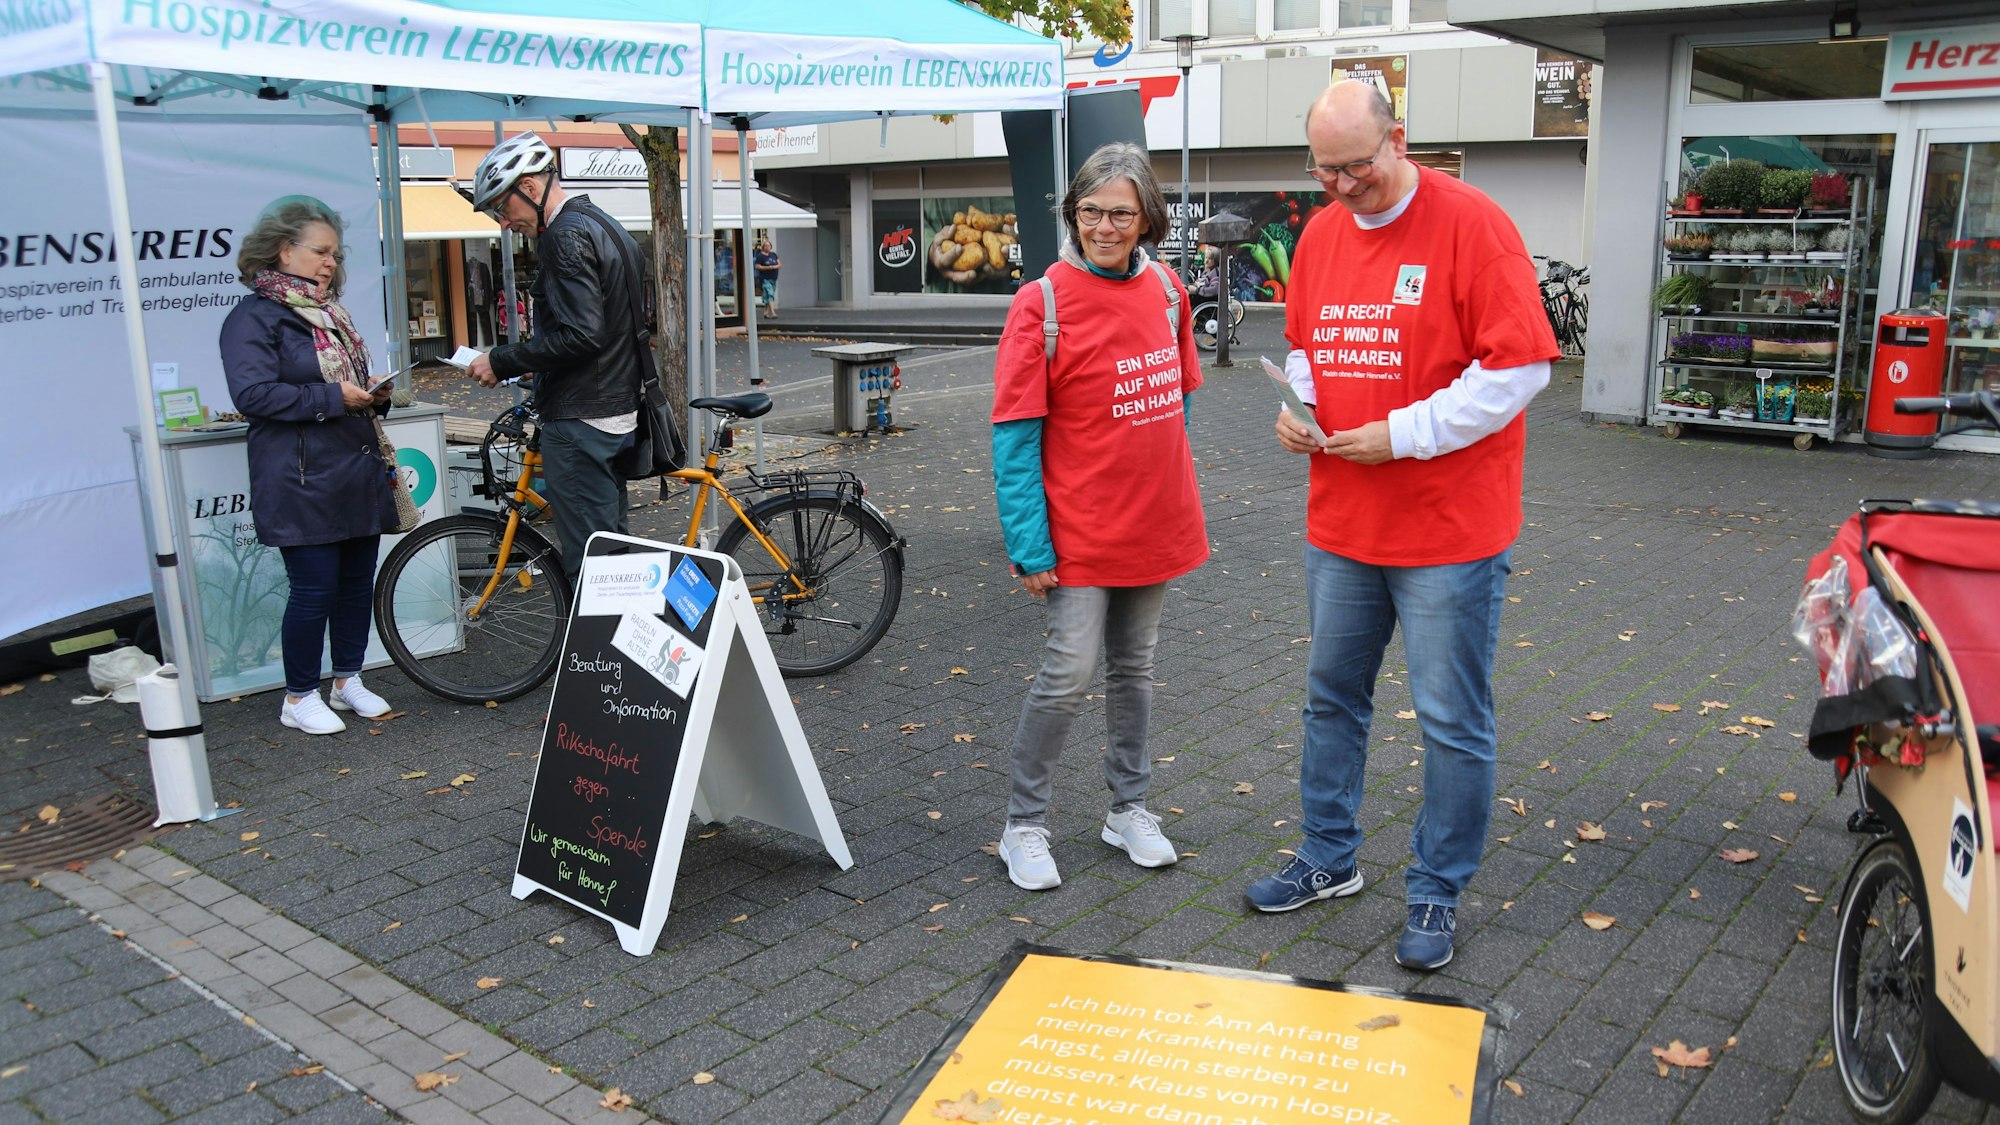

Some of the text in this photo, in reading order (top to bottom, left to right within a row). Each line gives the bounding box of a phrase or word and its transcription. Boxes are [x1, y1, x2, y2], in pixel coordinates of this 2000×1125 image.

[122, 0, 688, 78] Hospizverein LEBENSKREIS
[1906, 39, 2000, 71] Herz
[721, 51, 1053, 94] Hospizverein LEBENSKREIS
[1536, 66, 1575, 81] WEIN
[784, 131, 816, 147] hennef
[883, 228, 913, 248] HIT
[140, 270, 235, 289] ambulante
[60, 300, 95, 318] und
[1320, 304, 1395, 320] EIN RECHT
[1313, 327, 1399, 344] AUF WIND IN
[1116, 346, 1178, 375] EIN RECHT
[1338, 349, 1402, 367] HAAREN
[1114, 377, 1145, 398] AUF
[1147, 367, 1176, 388] WIND
[1112, 399, 1145, 418] DEN
[194, 493, 253, 519] LEB
[589, 573, 643, 585] LEBENSKREIS
[630, 613, 657, 638] RADELN
[626, 639, 647, 659] ALTER
[632, 629, 653, 649] OHNE
[568, 651, 622, 680] Beratung
[600, 681, 623, 695] und
[602, 697, 677, 725] Information
[573, 775, 609, 803] gegen
[530, 822, 548, 843] Wir
[586, 816, 647, 858] Spende
[558, 860, 617, 907] für Hennef
[1105, 1000, 1146, 1018] bin
[1154, 1008, 1199, 1025] tot.
[1205, 1015, 1251, 1032] Am
[1257, 1021, 1360, 1050] Anfang
[1036, 1015, 1407, 1077] meiner Krankheit hatte ich
[1019, 1033, 1350, 1094] Angst, allein sterben zu
[987, 1078, 1080, 1106] dienst
[1085, 1096, 1143, 1115] war
[1146, 1103, 1223, 1125] dann
[1004, 1058, 1401, 1125] müssen. Klaus vom Hospiz-
